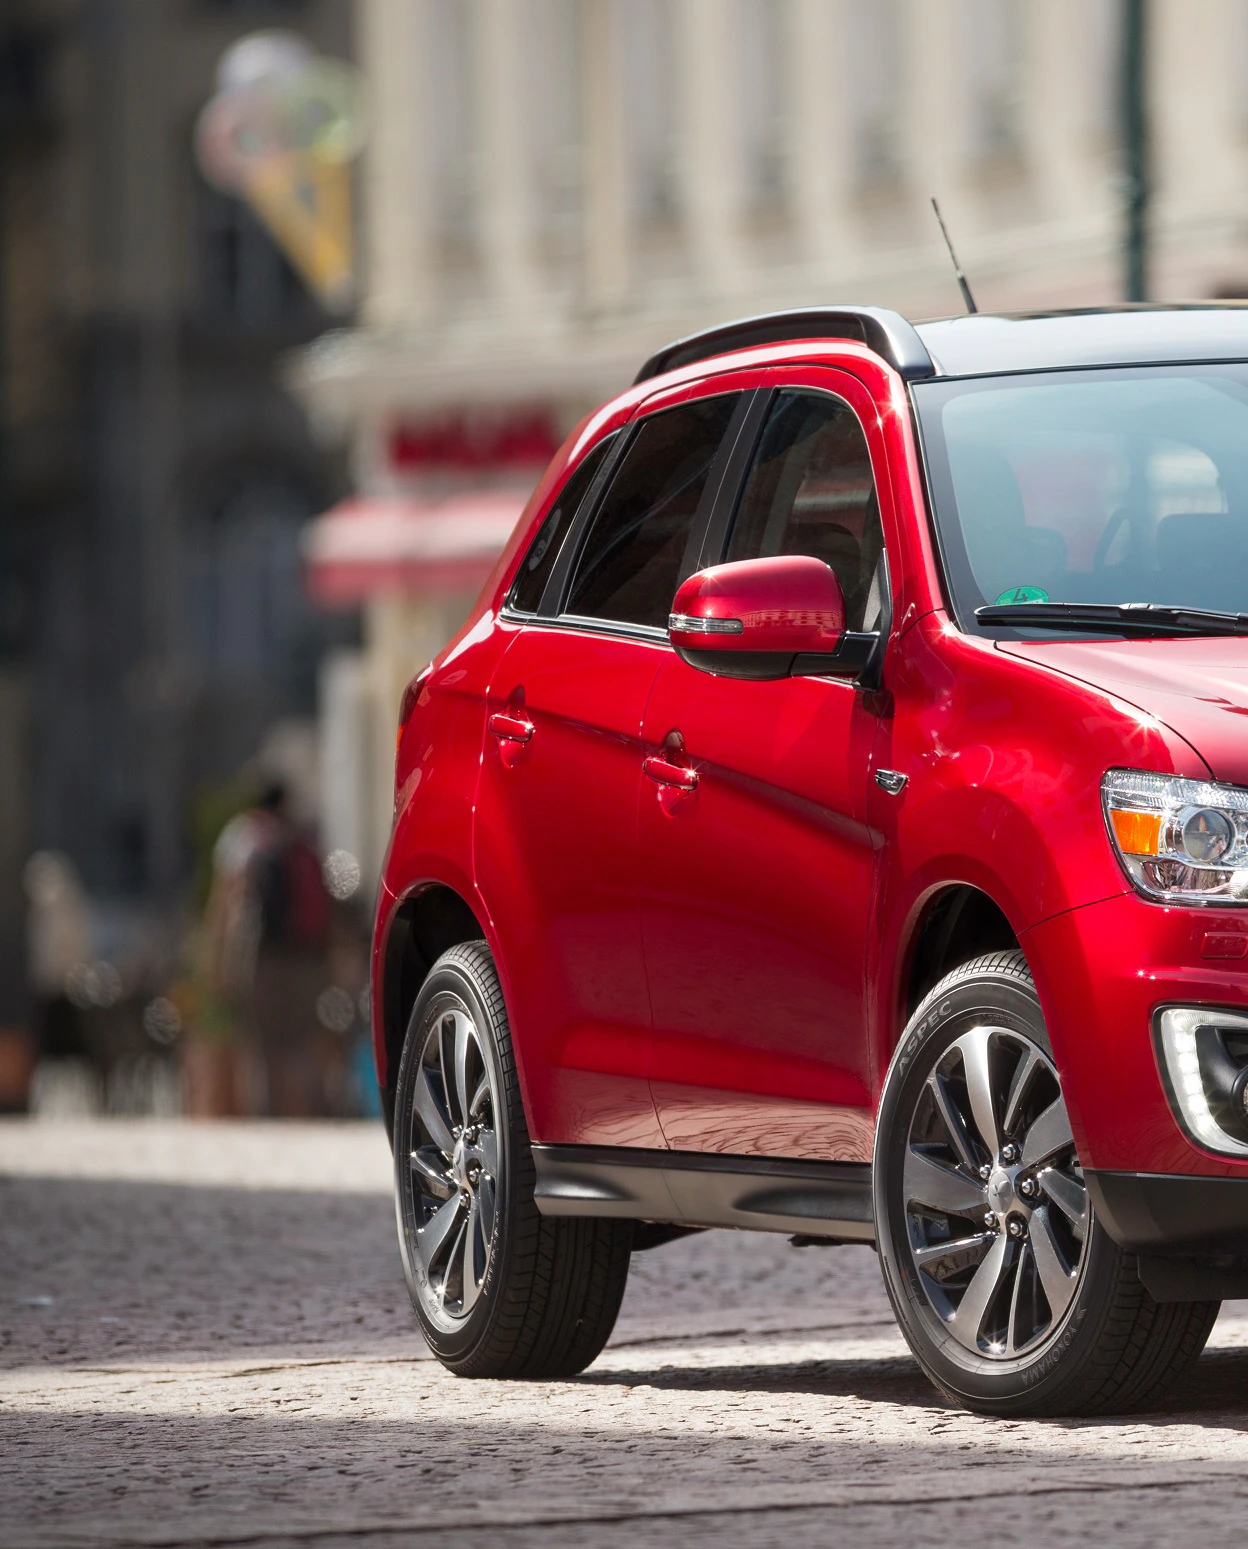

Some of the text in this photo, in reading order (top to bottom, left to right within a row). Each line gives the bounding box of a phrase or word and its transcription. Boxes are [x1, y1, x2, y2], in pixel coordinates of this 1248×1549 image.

[1013, 588, 1028, 602] 4
[900, 1001, 952, 1075] ASPEC
[1021, 1326, 1077, 1385] YOKOHAMA
